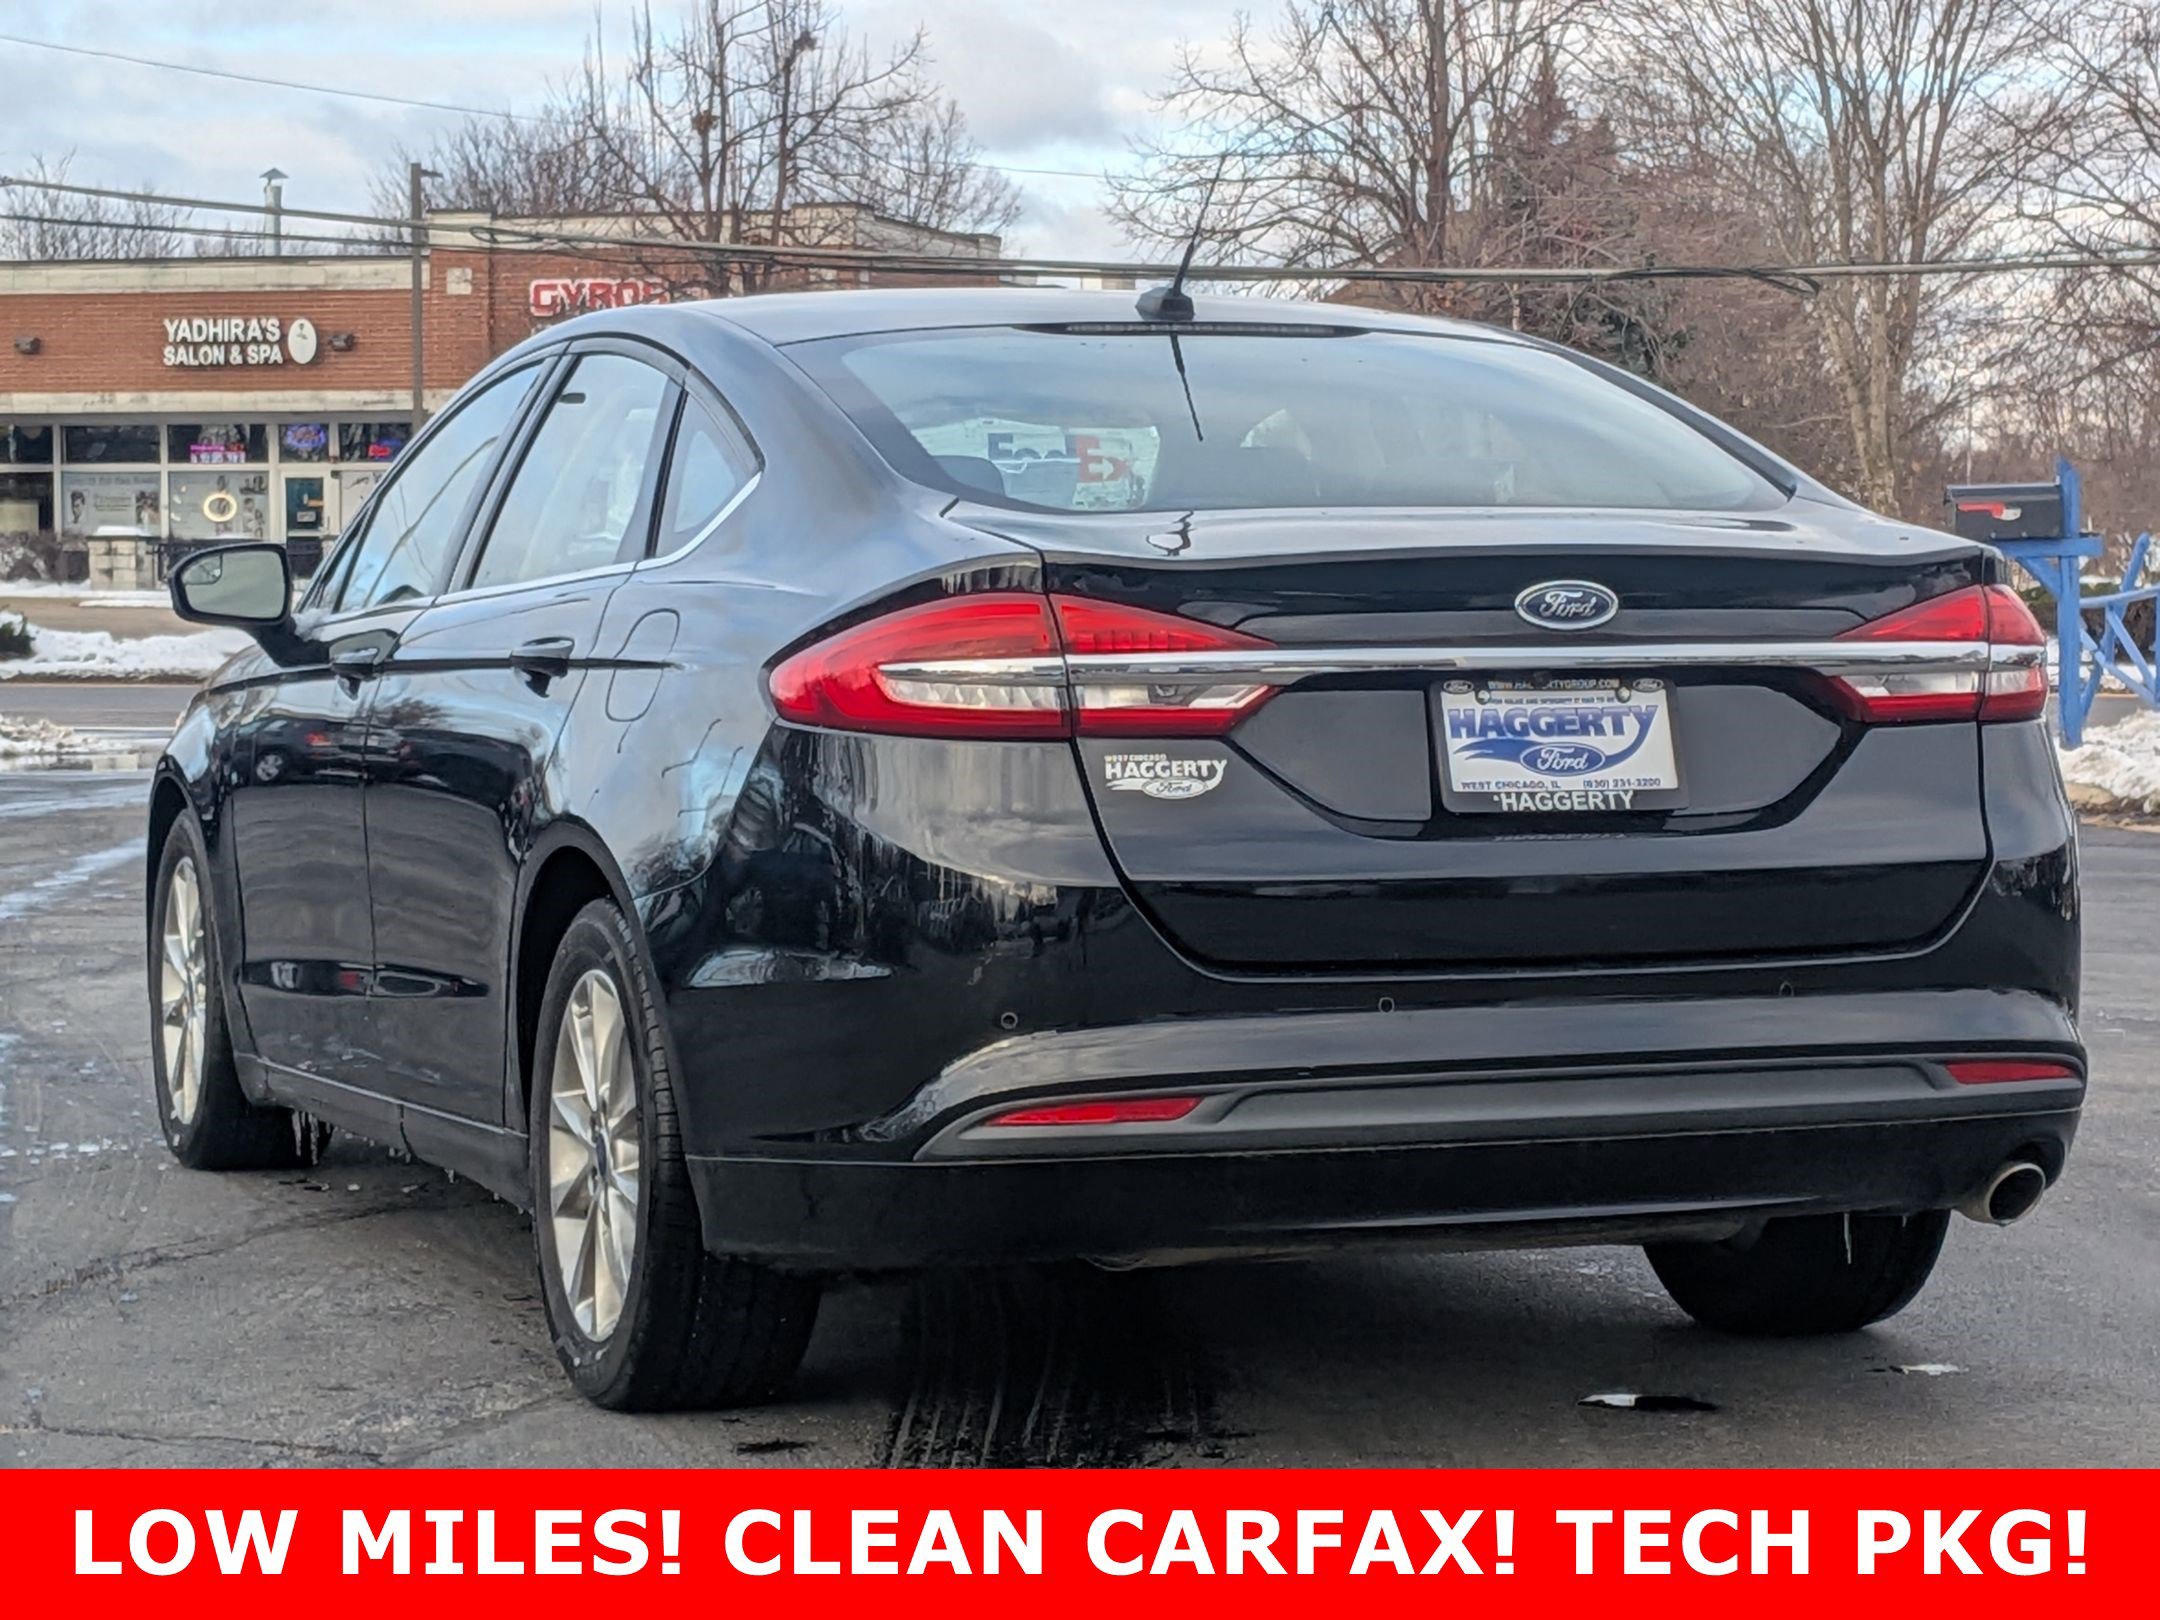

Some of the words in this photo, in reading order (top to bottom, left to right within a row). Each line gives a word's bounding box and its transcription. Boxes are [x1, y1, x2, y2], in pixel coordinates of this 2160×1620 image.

[163, 318, 281, 343] YADHIRA'S
[163, 345, 225, 366] SALON
[229, 345, 243, 365] &
[247, 344, 284, 365] SPA
[1539, 590, 1597, 617] Ford
[1447, 705, 1659, 742] HAGGERTY
[1104, 754, 1128, 762] WEST
[1129, 753, 1167, 762] CHICAGO
[1537, 747, 1588, 770] Ford
[1104, 759, 1228, 780] HAGGERTY
[1156, 781, 1193, 794] Ford
[1461, 781, 1491, 790] WEST
[1495, 780, 1549, 791] CHICAGO,
[1551, 780, 1561, 789] IL
[1501, 790, 1636, 811] HAGGERTY
